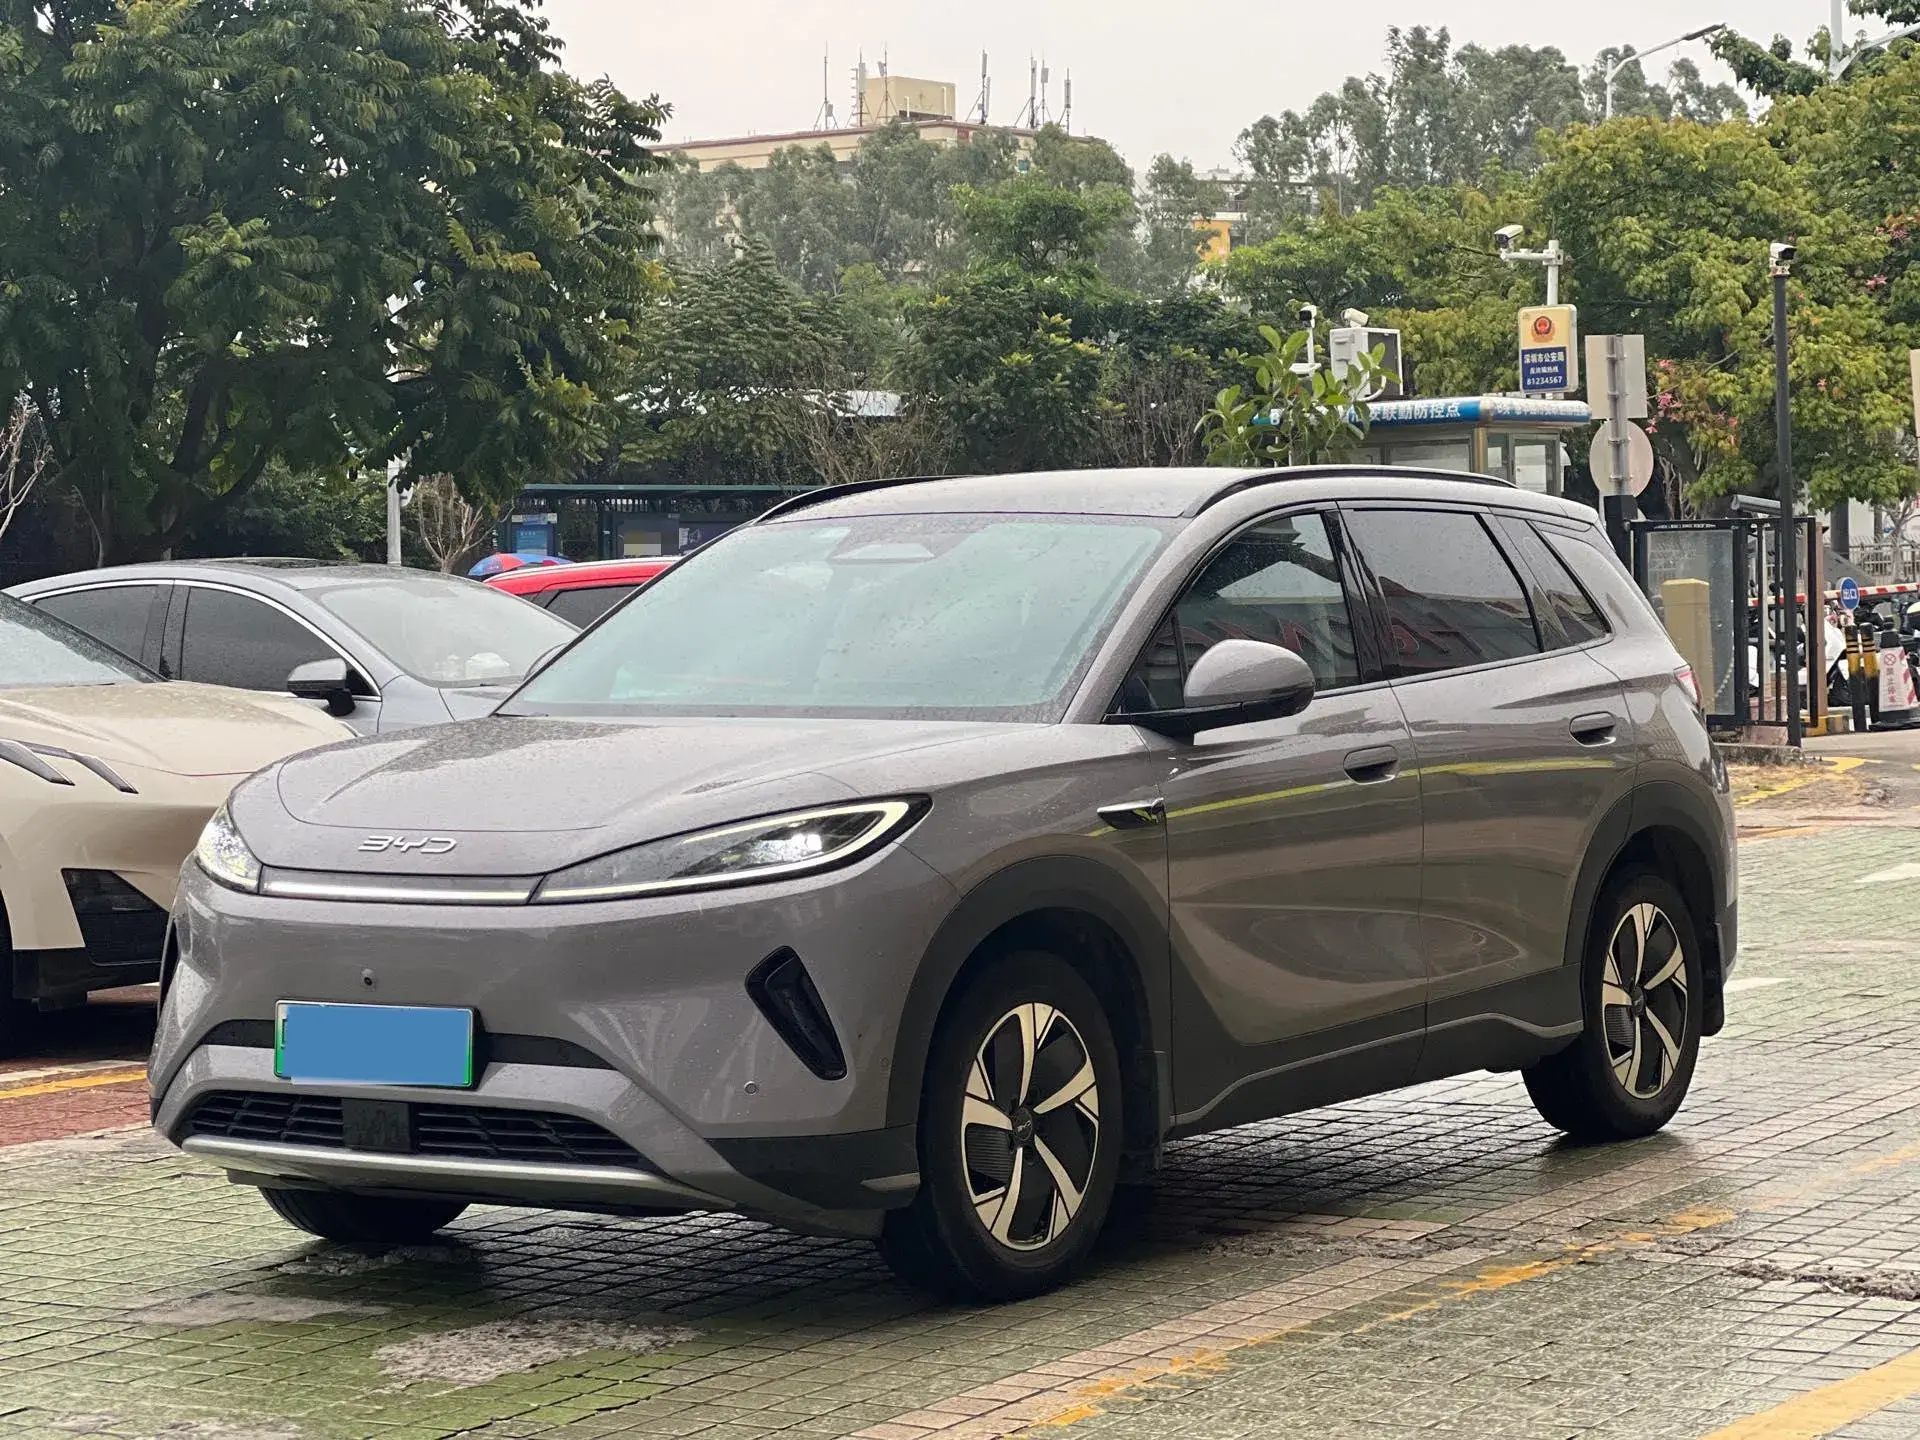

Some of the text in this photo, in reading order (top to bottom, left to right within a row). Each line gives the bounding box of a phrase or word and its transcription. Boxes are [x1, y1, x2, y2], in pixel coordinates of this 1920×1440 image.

[1523, 352, 1565, 364] 深圳市公安局
[1526, 376, 1563, 386] 81234567
[1842, 588, 1858, 600] 出口
[358, 835, 457, 854] BYD
